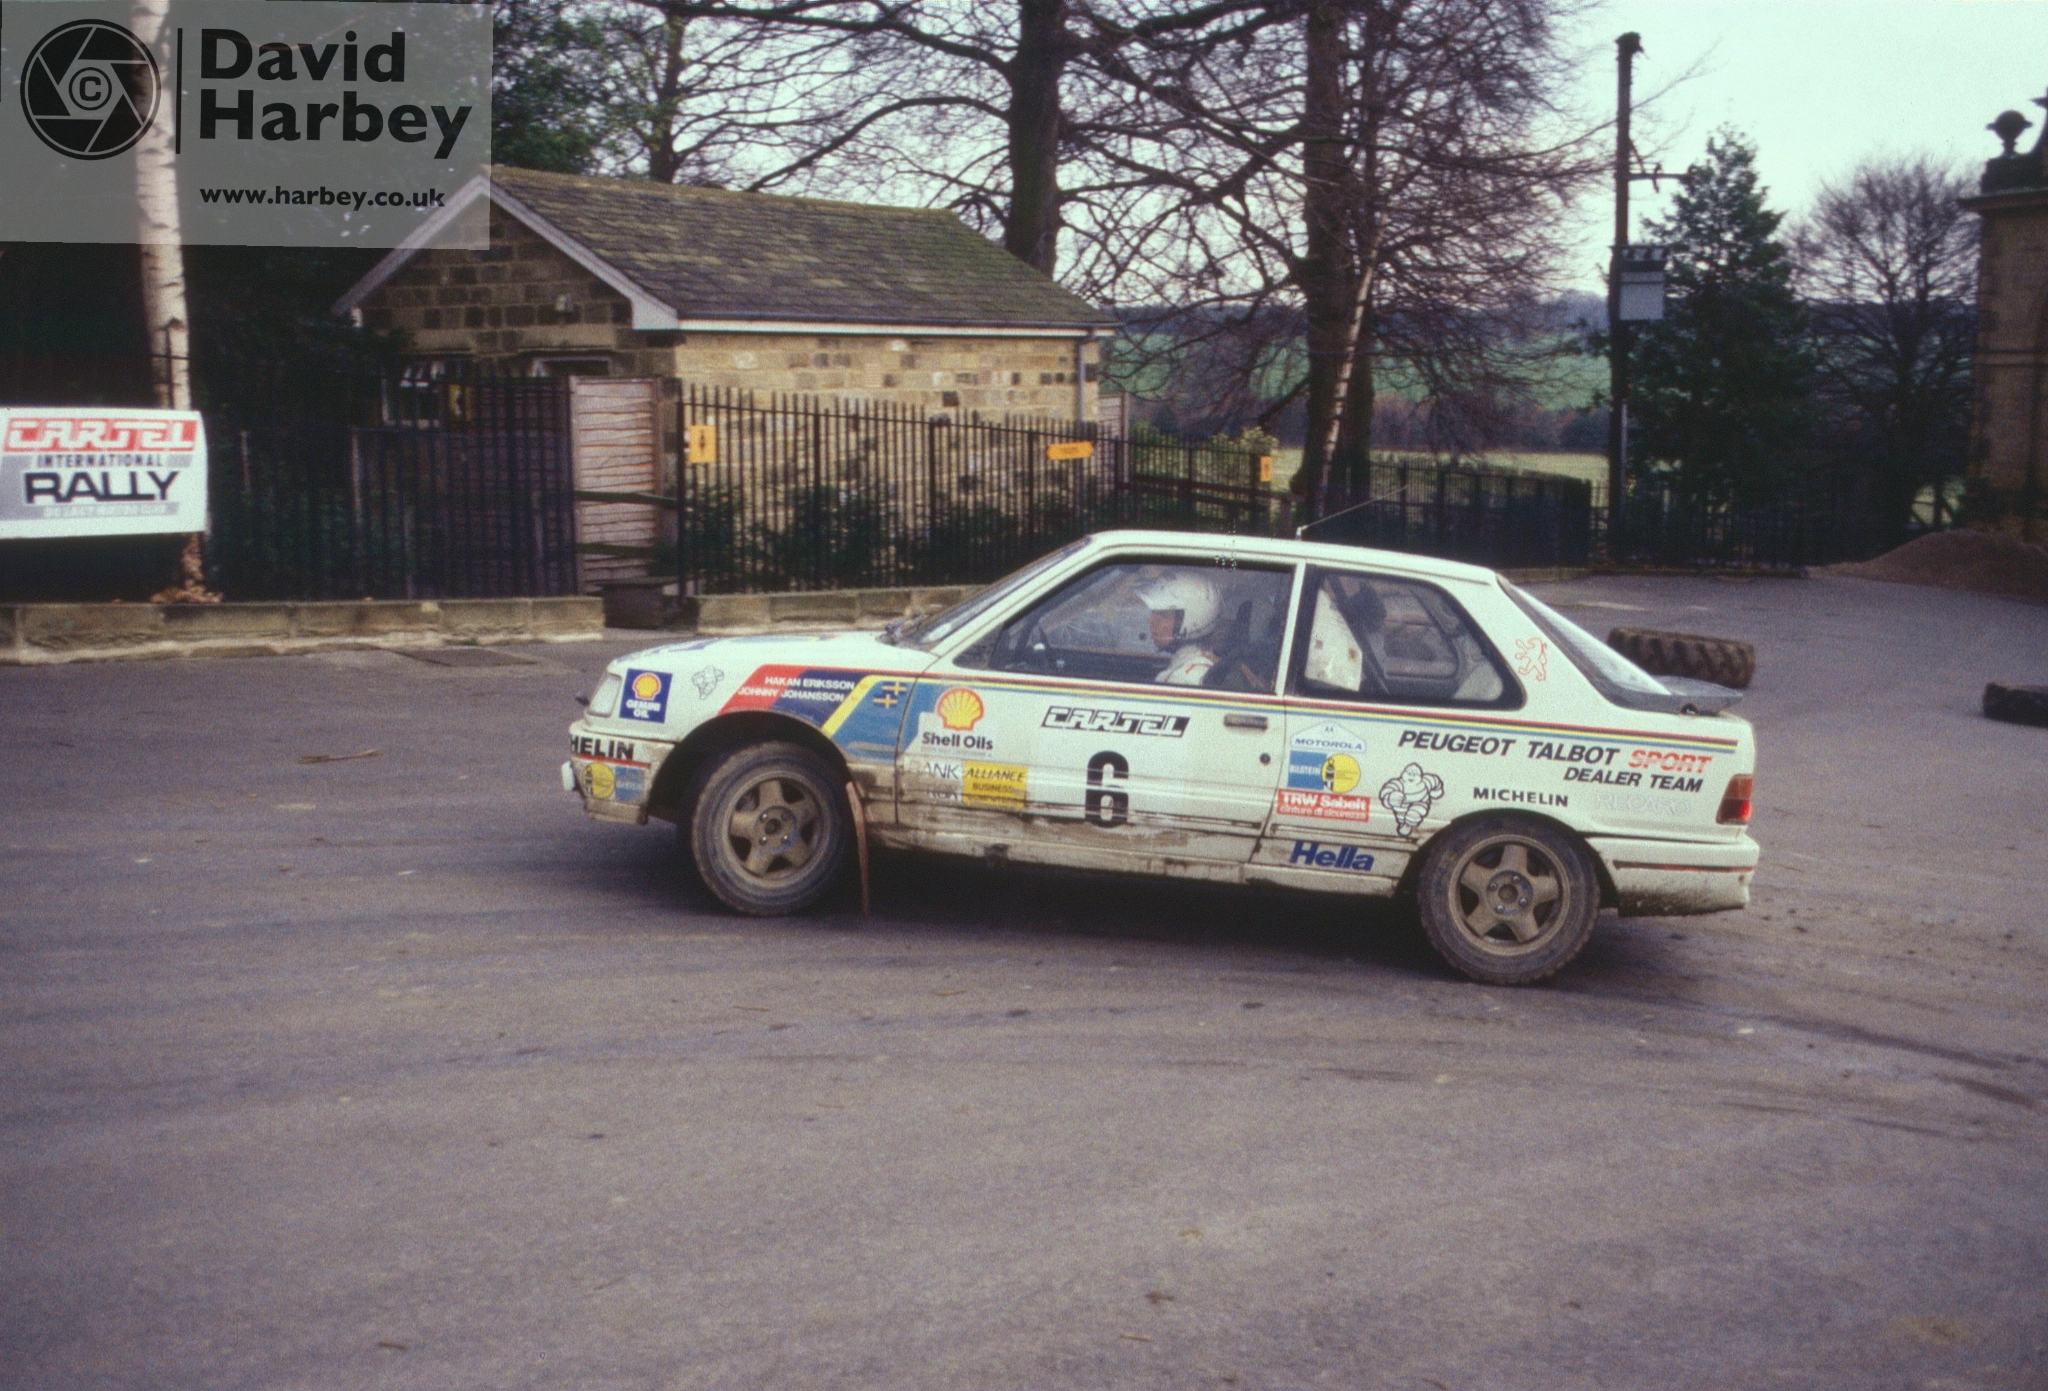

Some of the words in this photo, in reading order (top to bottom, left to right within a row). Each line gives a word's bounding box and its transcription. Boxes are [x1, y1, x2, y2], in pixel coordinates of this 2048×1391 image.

[4, 417, 198, 452] CARTEL
[37, 453, 164, 468] INTERNATIONAL
[24, 471, 180, 504] RALLY
[738, 686, 780, 697] JOHNNY
[781, 689, 845, 702] JOHANSSON
[802, 678, 855, 690] ERIKSSON
[626, 699, 661, 712] GEMINI
[633, 708, 650, 718] OIL
[1040, 706, 1191, 738] CARTEL
[921, 731, 961, 747] Shell
[963, 735, 994, 750] Oils
[1294, 737, 1363, 751] MOTOROLA
[1397, 730, 1516, 756] PEUGEOT
[1526, 741, 1621, 766] TALBOT
[1628, 749, 1713, 774] SPORT
[908, 759, 960, 780] ANK
[964, 767, 1024, 782] ALLIANCE
[1085, 750, 1129, 828] 6
[1563, 767, 1642, 787] DEALER
[1649, 773, 1704, 793] TEAM
[1281, 791, 1318, 806] TRW
[1320, 794, 1366, 810] Sabelt
[1472, 786, 1569, 808] MICHELIN
[1289, 840, 1375, 872] Hella
